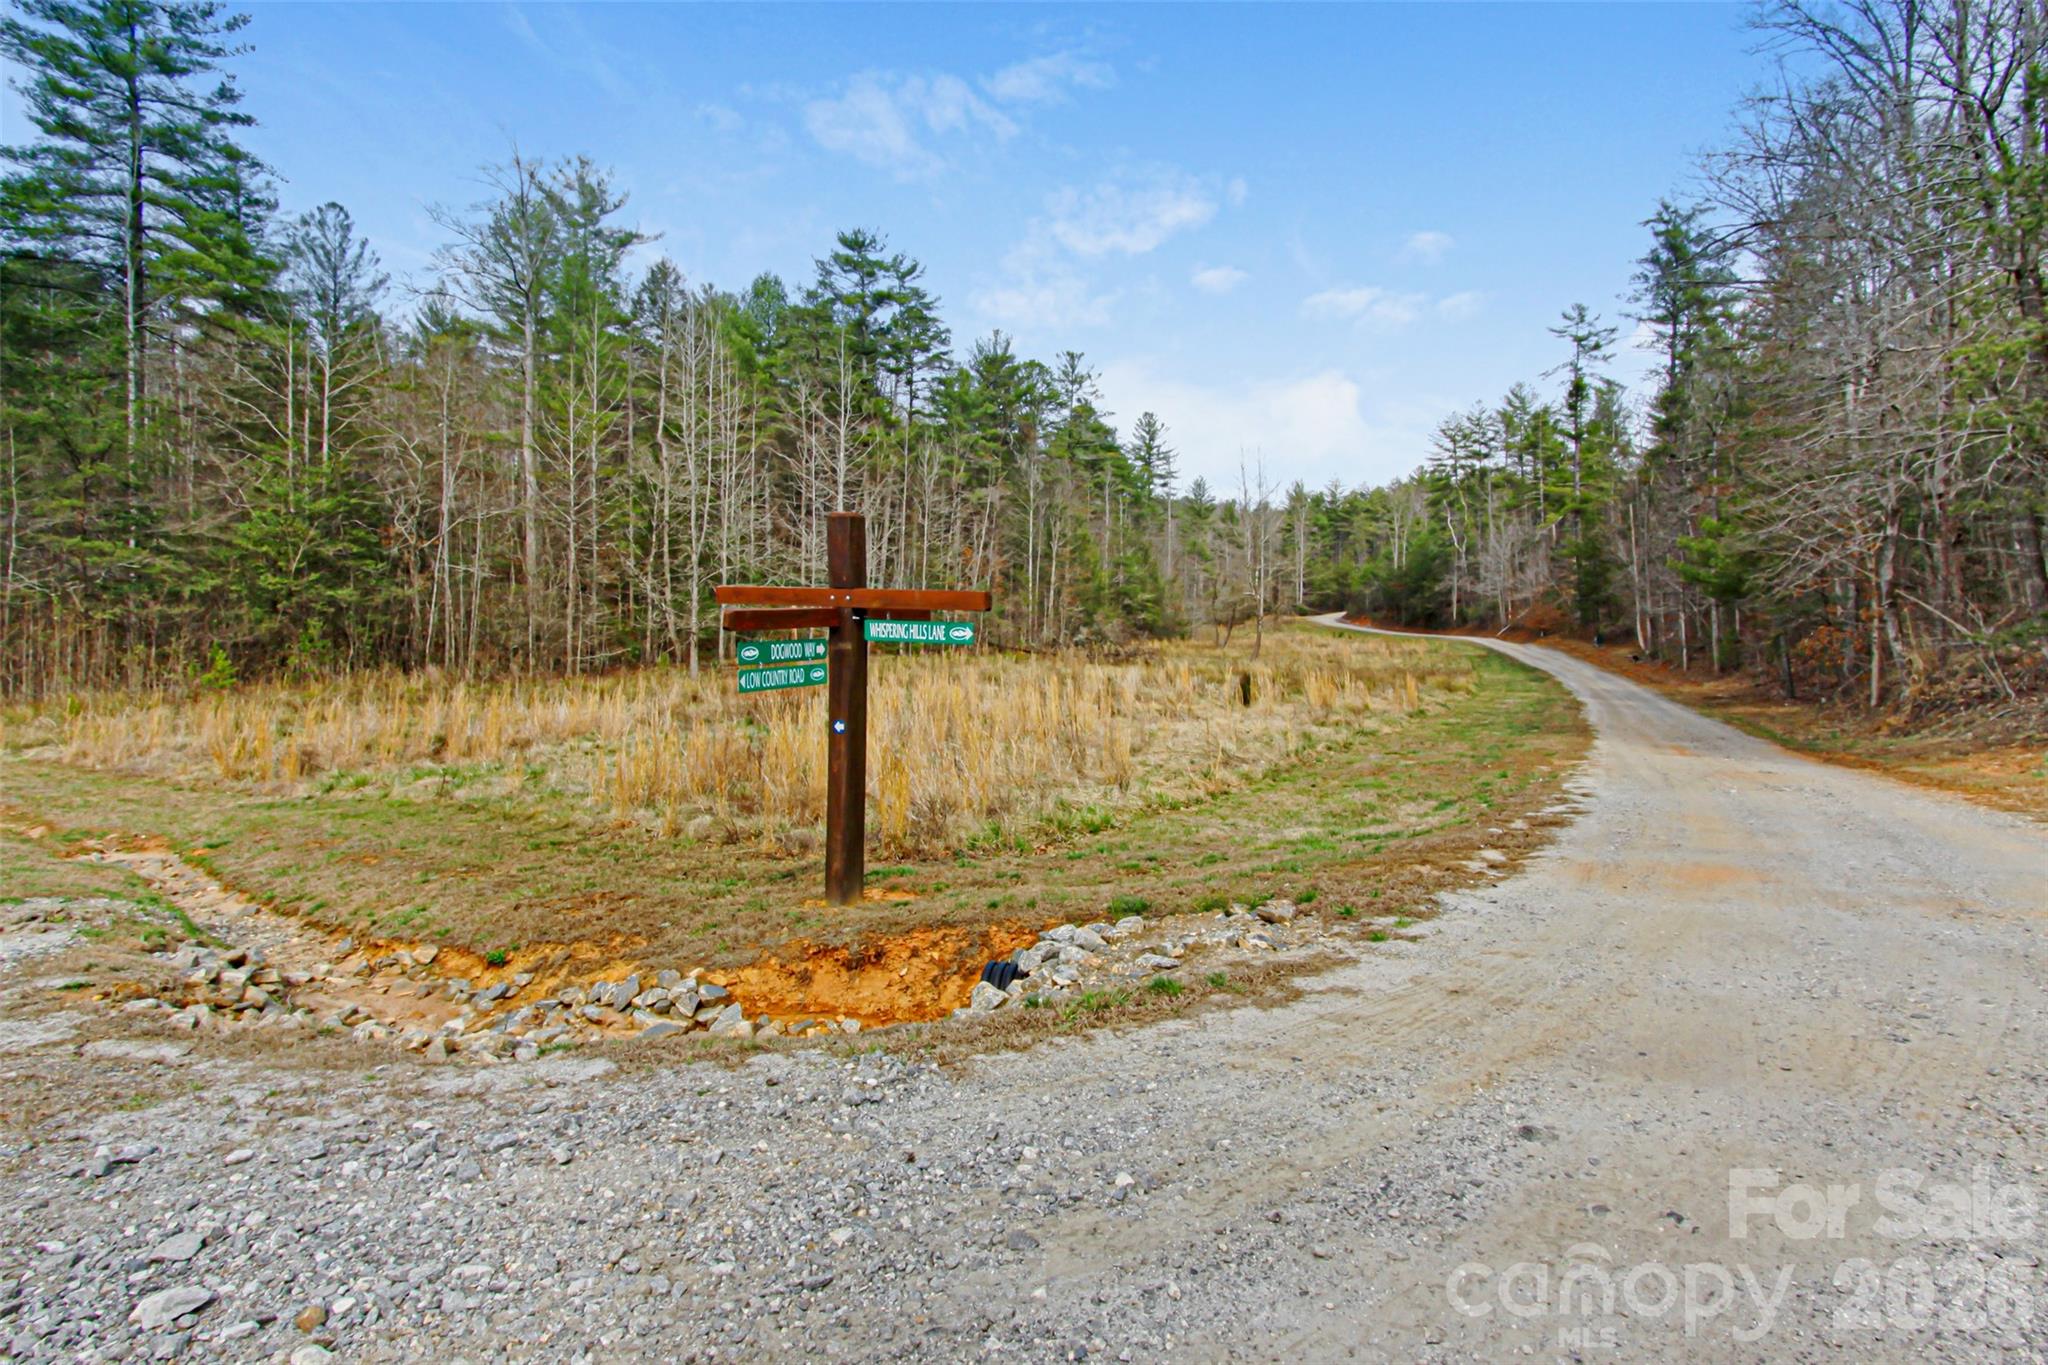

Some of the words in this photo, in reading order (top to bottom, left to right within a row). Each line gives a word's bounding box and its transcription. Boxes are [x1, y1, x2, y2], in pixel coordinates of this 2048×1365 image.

[869, 622, 909, 640] WHISPERING
[909, 624, 927, 640] HILLS
[928, 625, 946, 641] LANE
[770, 643, 803, 660] DOGWOOD
[804, 642, 816, 657] WAY
[746, 672, 761, 689] LOW
[761, 669, 788, 687] COUNTRY
[789, 668, 805, 683] ROAD
